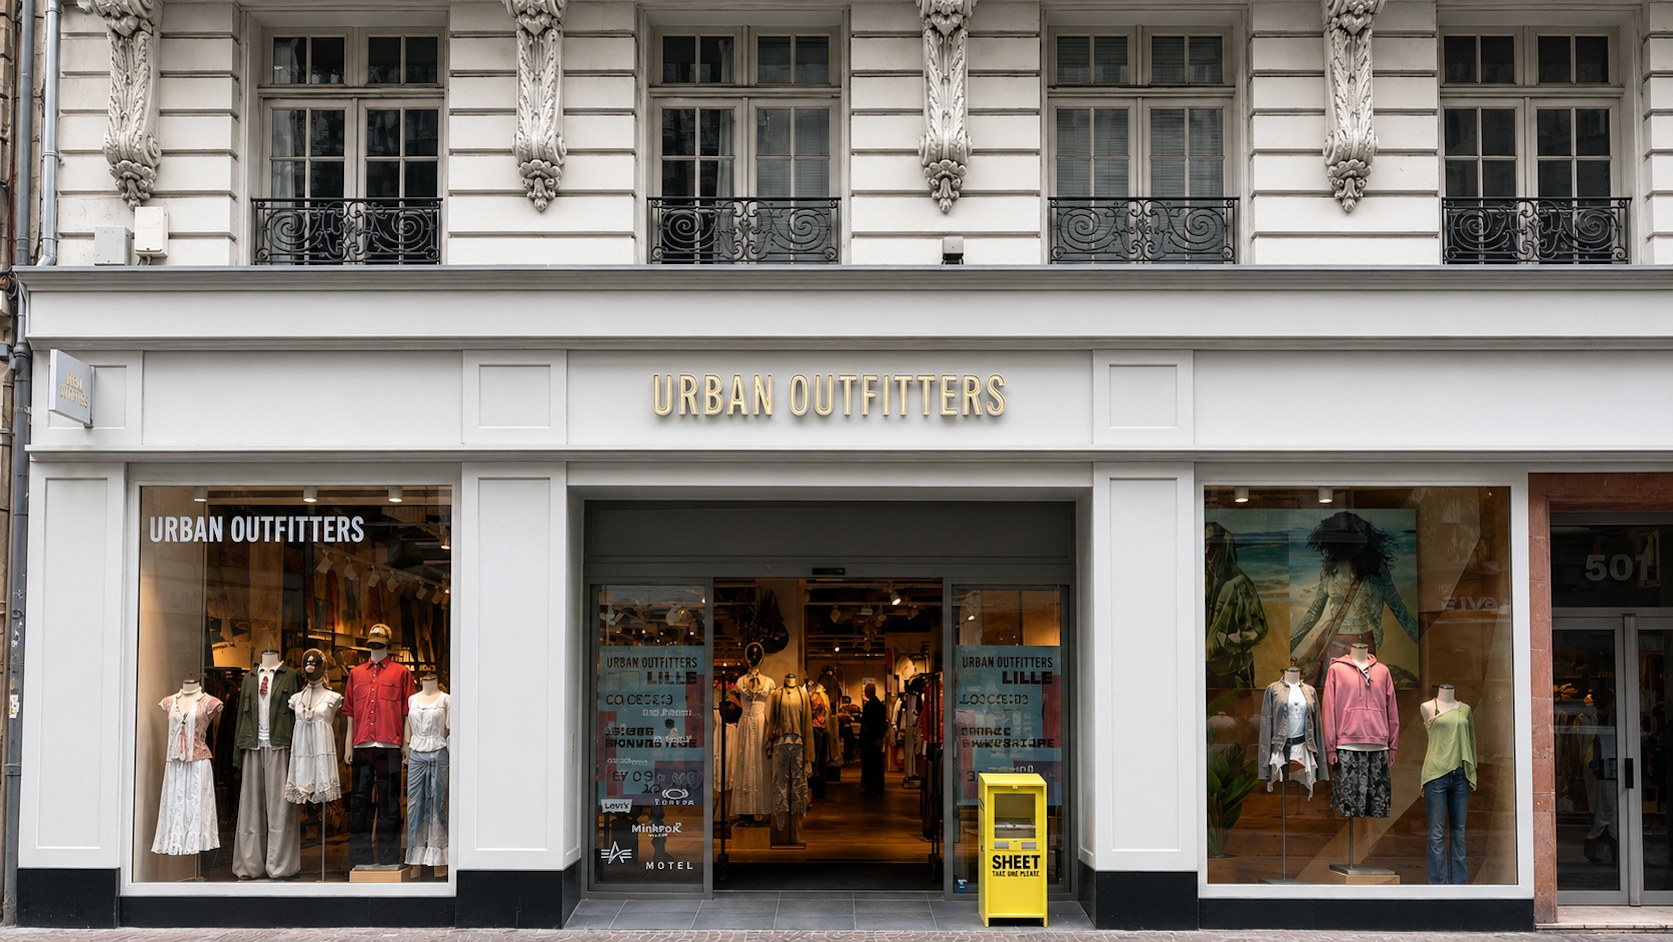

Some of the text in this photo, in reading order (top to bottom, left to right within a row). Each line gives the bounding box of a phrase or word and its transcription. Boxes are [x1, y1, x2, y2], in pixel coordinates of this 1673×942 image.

[652, 373, 1007, 416] URBAN OUTFITTERS
[150, 516, 365, 543] URBAN OUTFITTERS
[1585, 554, 1650, 581] 501
[606, 656, 698, 668] URBAN OUTFITTERS
[962, 656, 1053, 668] URBAN OUTFITTERS
[647, 671, 697, 685] LILLE
[1002, 671, 1053, 684] LILLE
[645, 861, 693, 870] MOTEL
[992, 854, 1041, 869] SHEET
